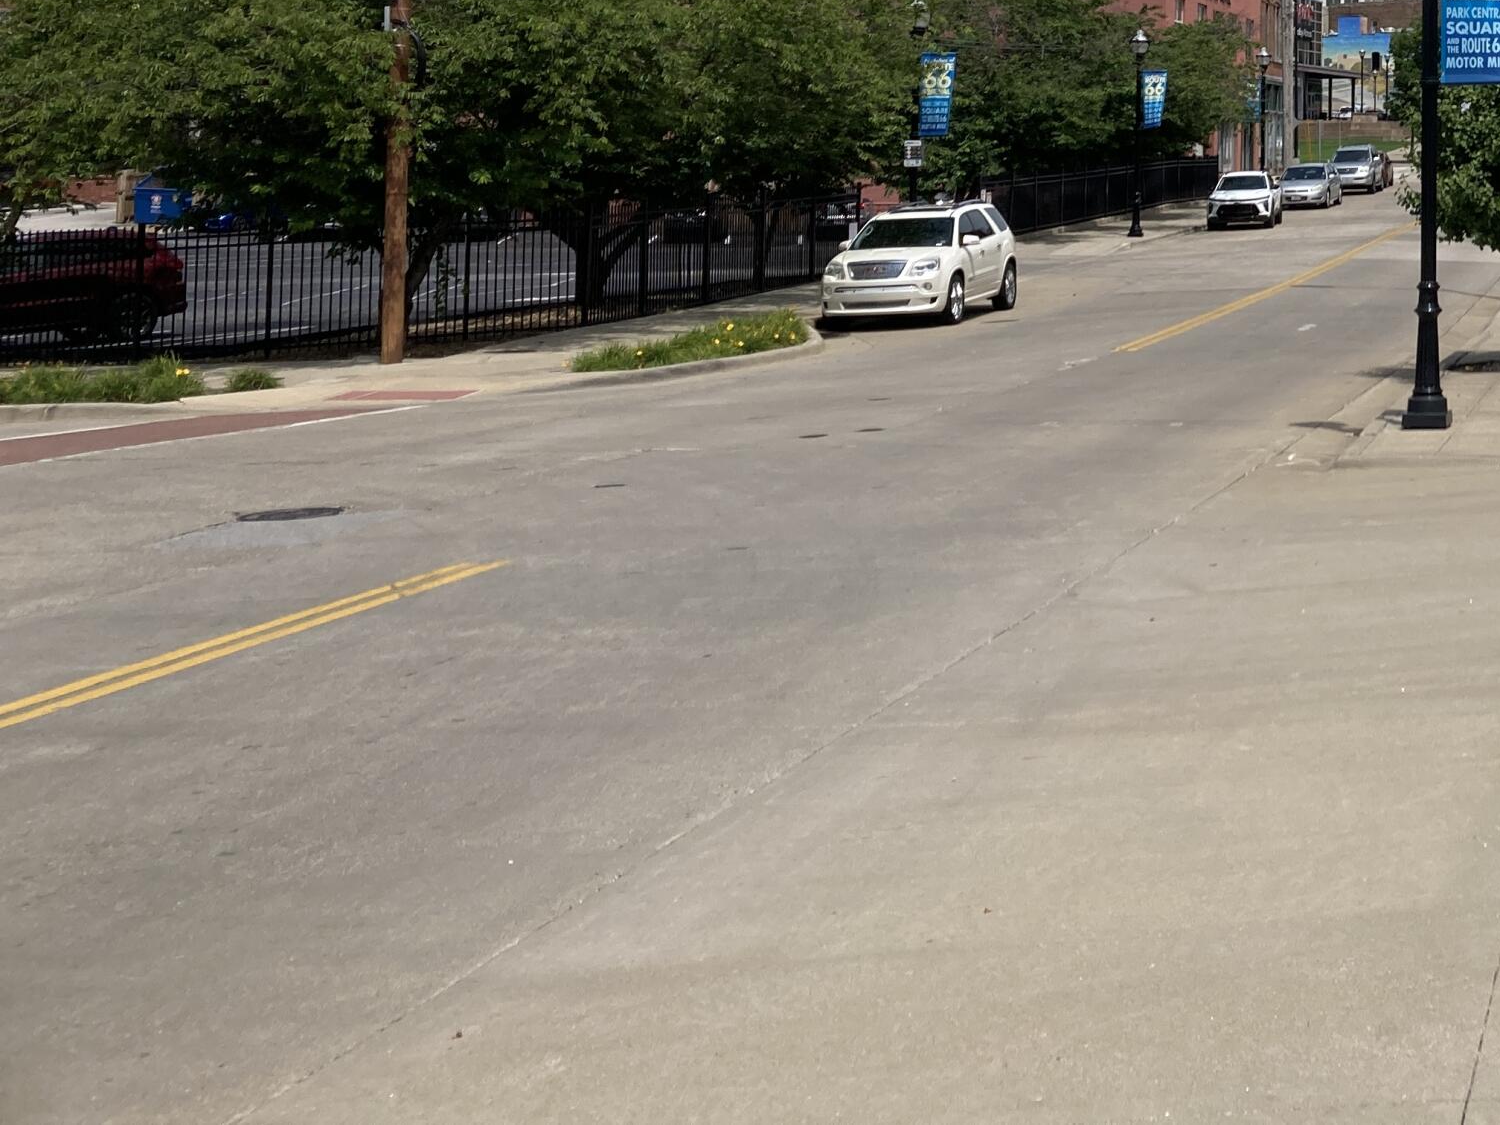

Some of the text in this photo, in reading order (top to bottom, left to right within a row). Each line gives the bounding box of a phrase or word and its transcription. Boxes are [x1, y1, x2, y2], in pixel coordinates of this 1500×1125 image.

[1446, 7, 1470, 19] PARK
[1446, 37, 1459, 45] AND
[1461, 37, 1491, 53] ROUTE
[1447, 45, 1459, 54] THE
[1446, 56, 1484, 69] MOTOR
